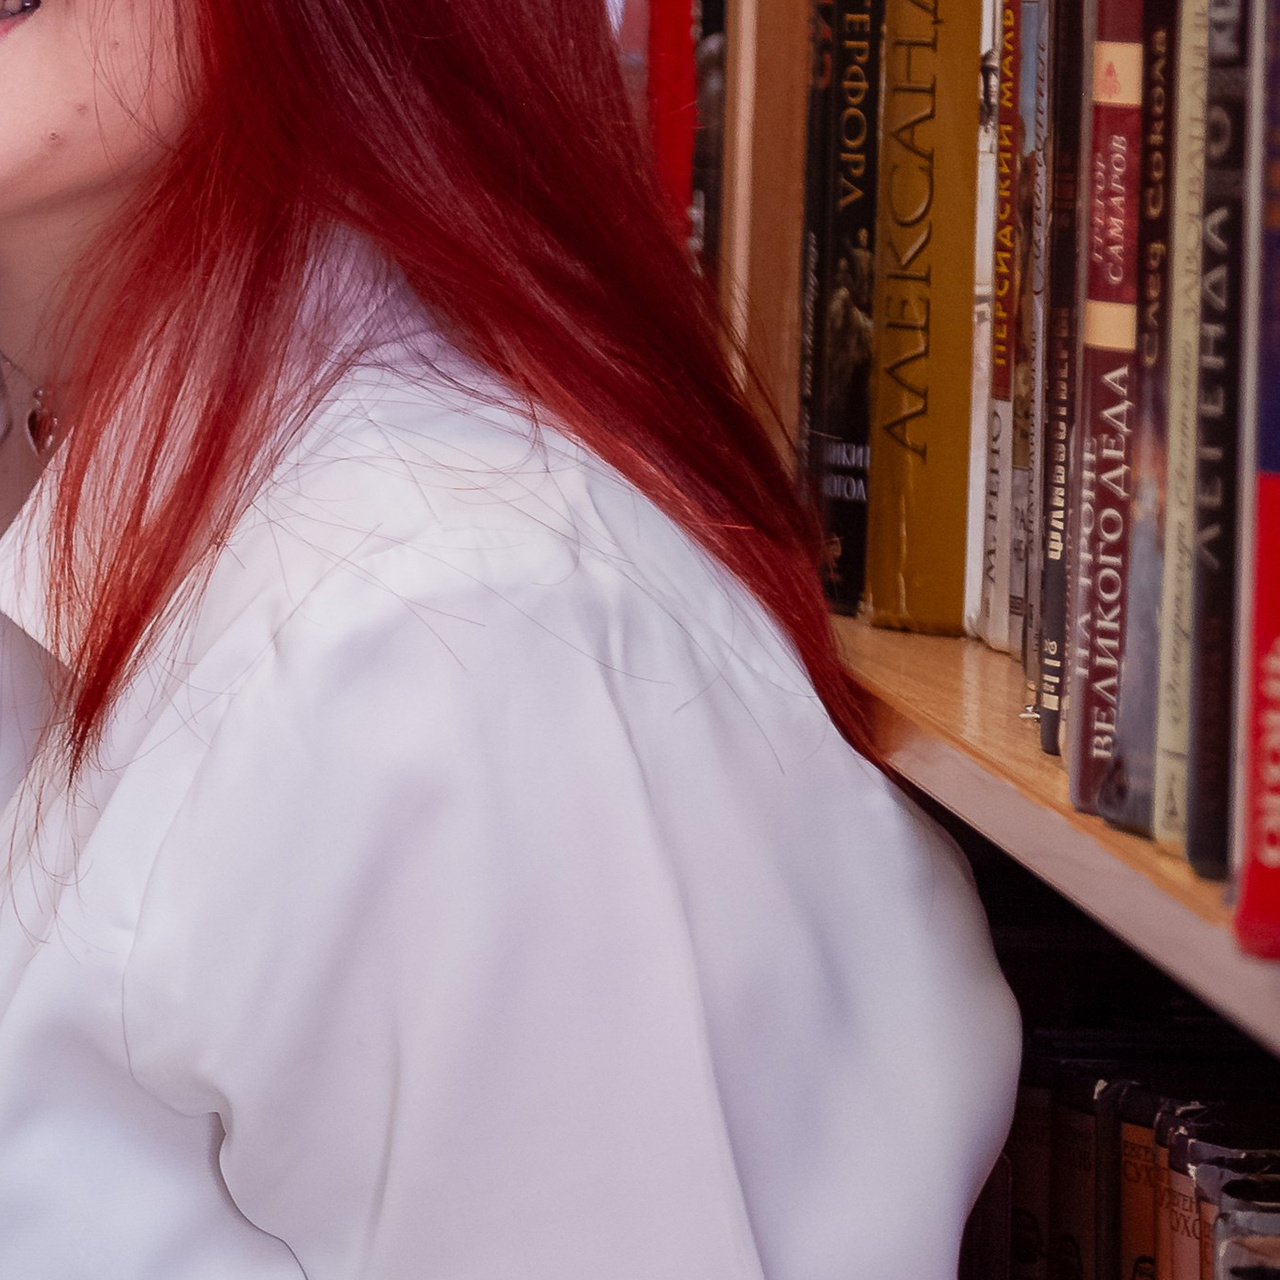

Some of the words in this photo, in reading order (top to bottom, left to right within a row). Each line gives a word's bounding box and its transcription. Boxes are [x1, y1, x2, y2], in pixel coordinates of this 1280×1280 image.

[1107, 133, 1127, 285] САМАРОВ
[1098, 364, 1136, 500] ДЕДА
[1089, 507, 1124, 761] ВЕЛИКОГО
